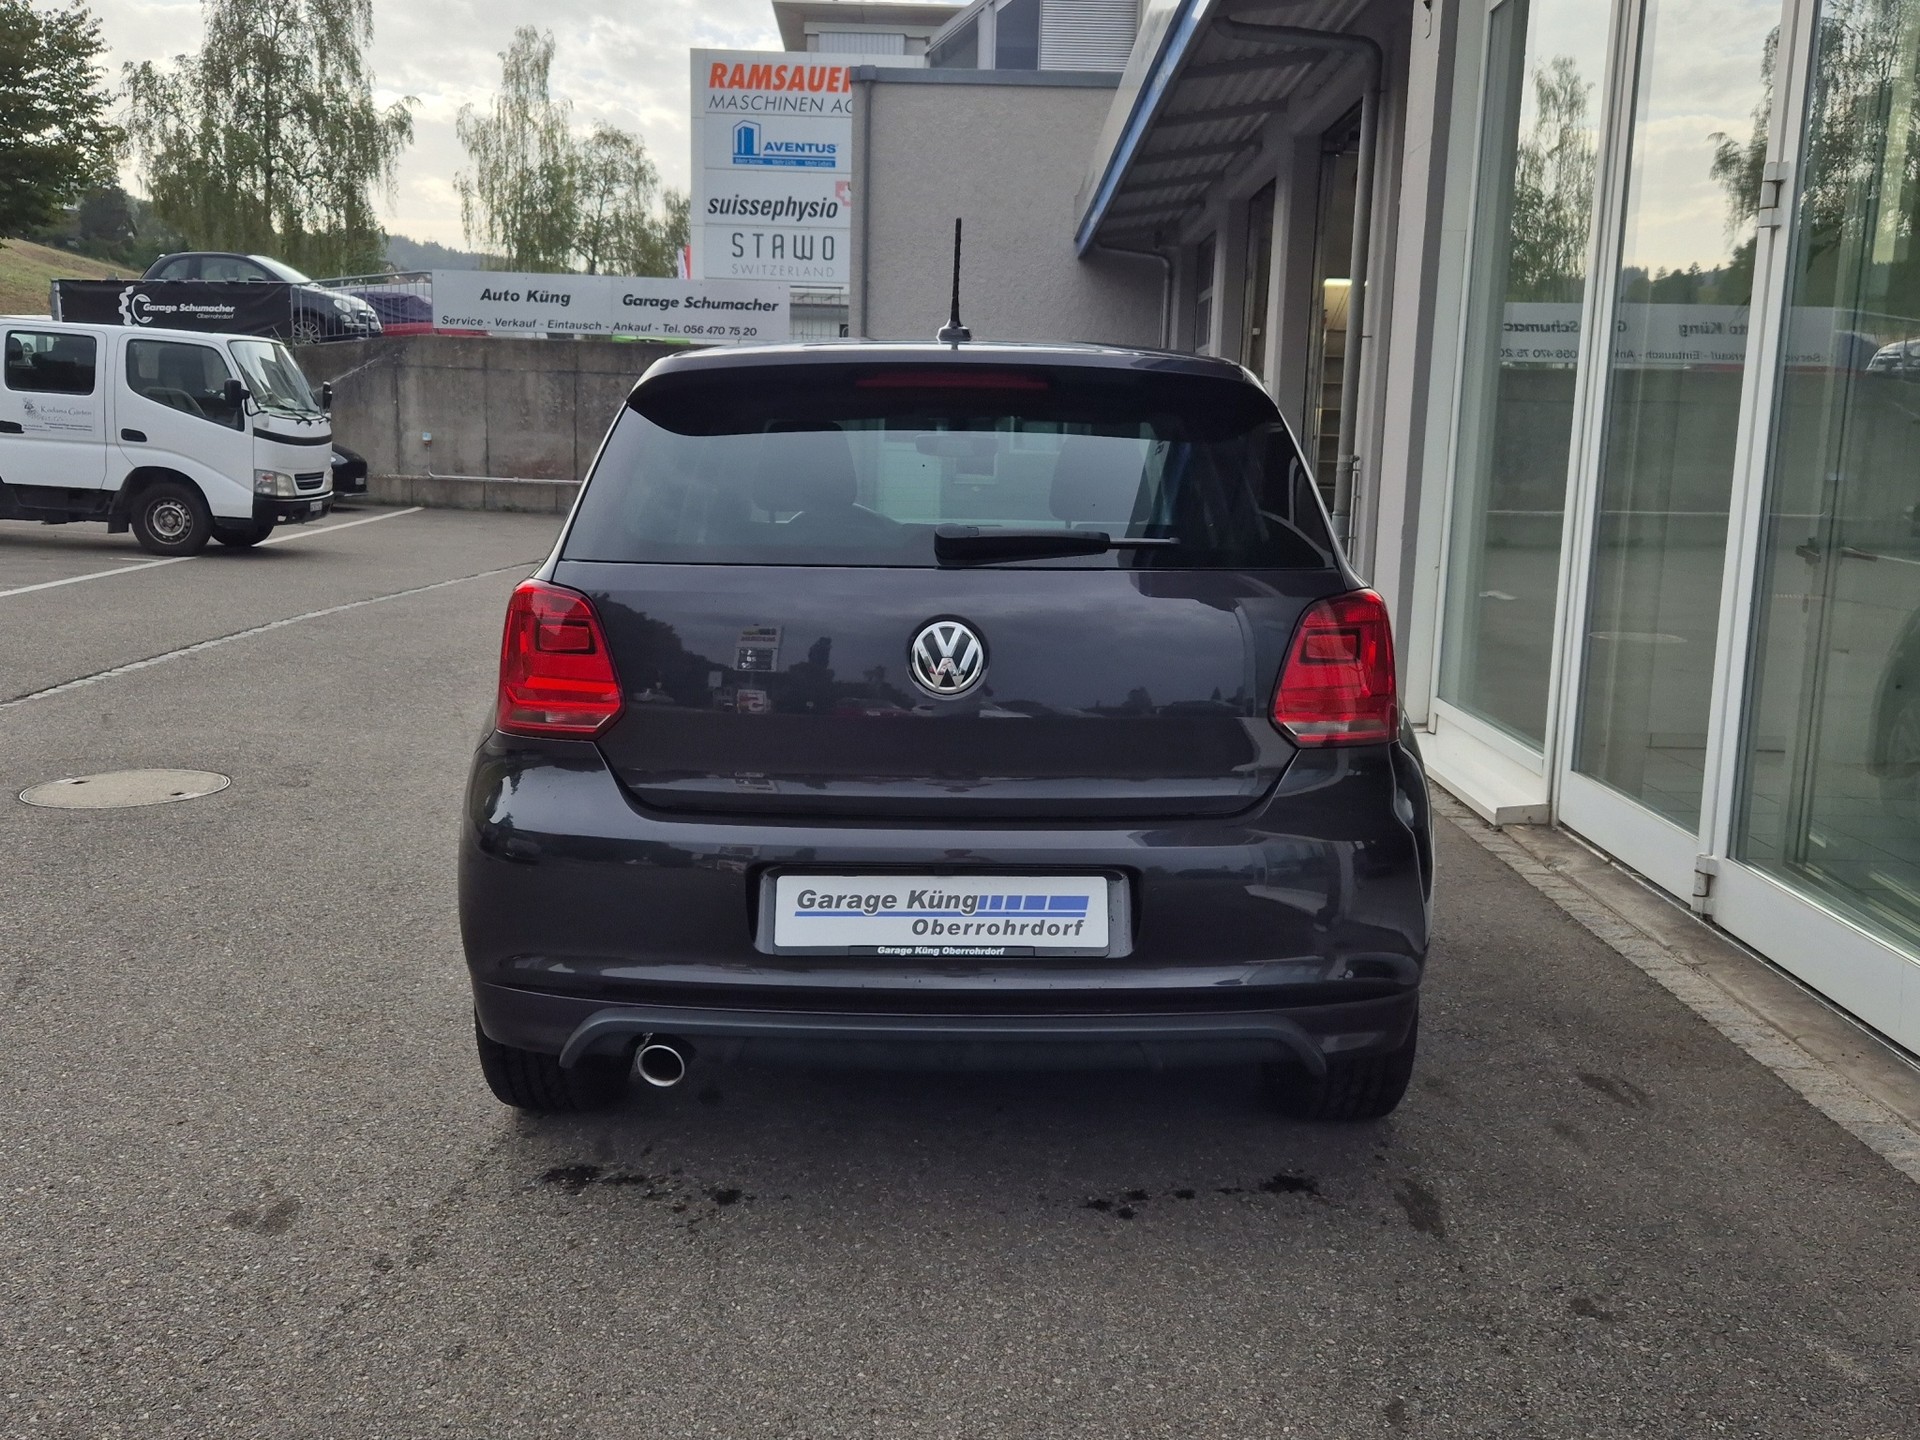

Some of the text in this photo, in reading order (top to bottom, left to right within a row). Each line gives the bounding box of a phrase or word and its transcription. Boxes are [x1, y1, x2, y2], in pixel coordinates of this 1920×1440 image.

[708, 94, 825, 113] MASCHINEN
[763, 141, 837, 154] AVENTUS
[707, 194, 839, 222] suissephysio
[731, 231, 836, 261] STAWO
[731, 263, 835, 278] SWITZERLAND
[480, 288, 571, 307] Auto Küng
[622, 293, 779, 312] Garage Schumacher
[143, 302, 235, 314] Garage Schumacher
[441, 315, 484, 326] Service
[495, 317, 537, 328] Verkauf
[547, 319, 602, 331] Eintausch
[612, 321, 652, 333] Ankauf
[663, 323, 681, 334] Tel.
[683, 325, 704, 335] 056
[706, 326, 726, 335] 470
[729, 326, 741, 335] 75
[743, 327, 758, 337] 20
[796, 889, 979, 915] Garage Küng
[911, 918, 1085, 937] Oberrohrdorf
[877, 946, 1006, 957] Garage Küng Oberrohrdorf
